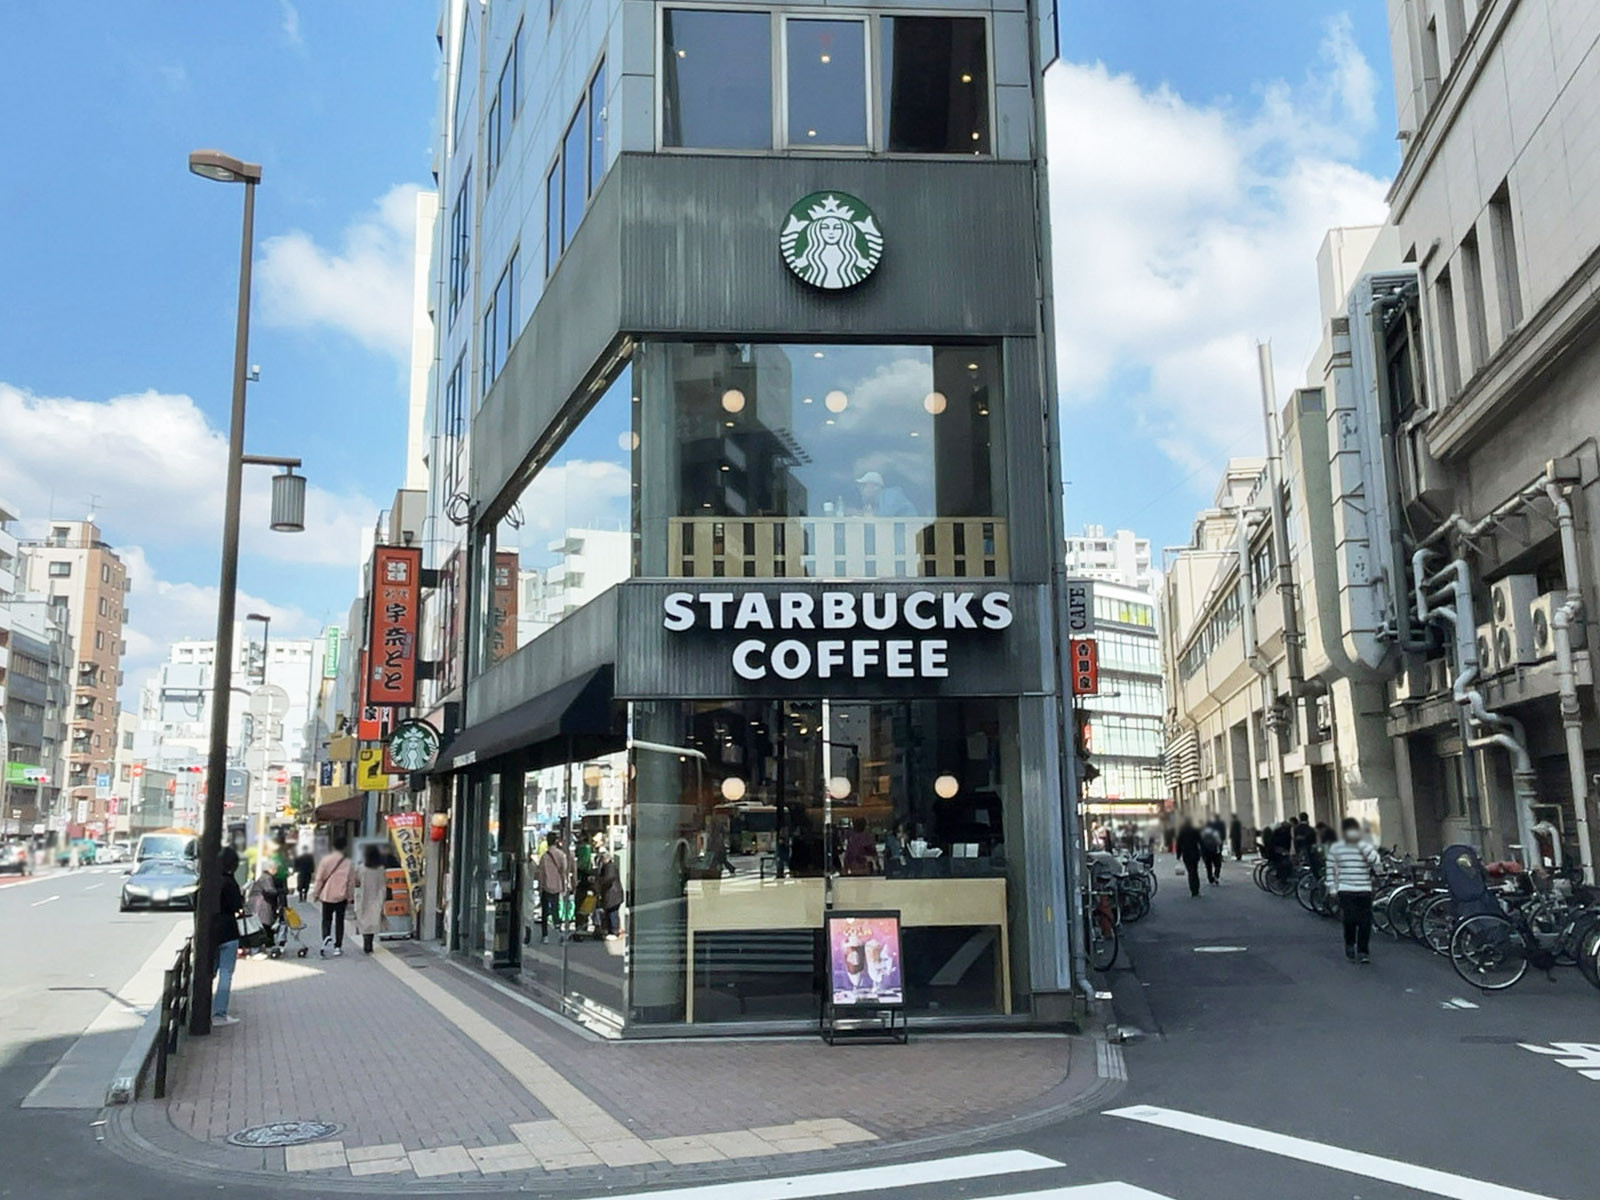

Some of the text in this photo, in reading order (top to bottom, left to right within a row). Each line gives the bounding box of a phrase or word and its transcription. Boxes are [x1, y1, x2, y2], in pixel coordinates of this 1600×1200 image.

[663, 591, 1013, 631] STARBUCKS
[1069, 587, 1086, 630] CAFE
[384, 602, 406, 690] 宇奈とと
[732, 639, 949, 679] COFFEE
